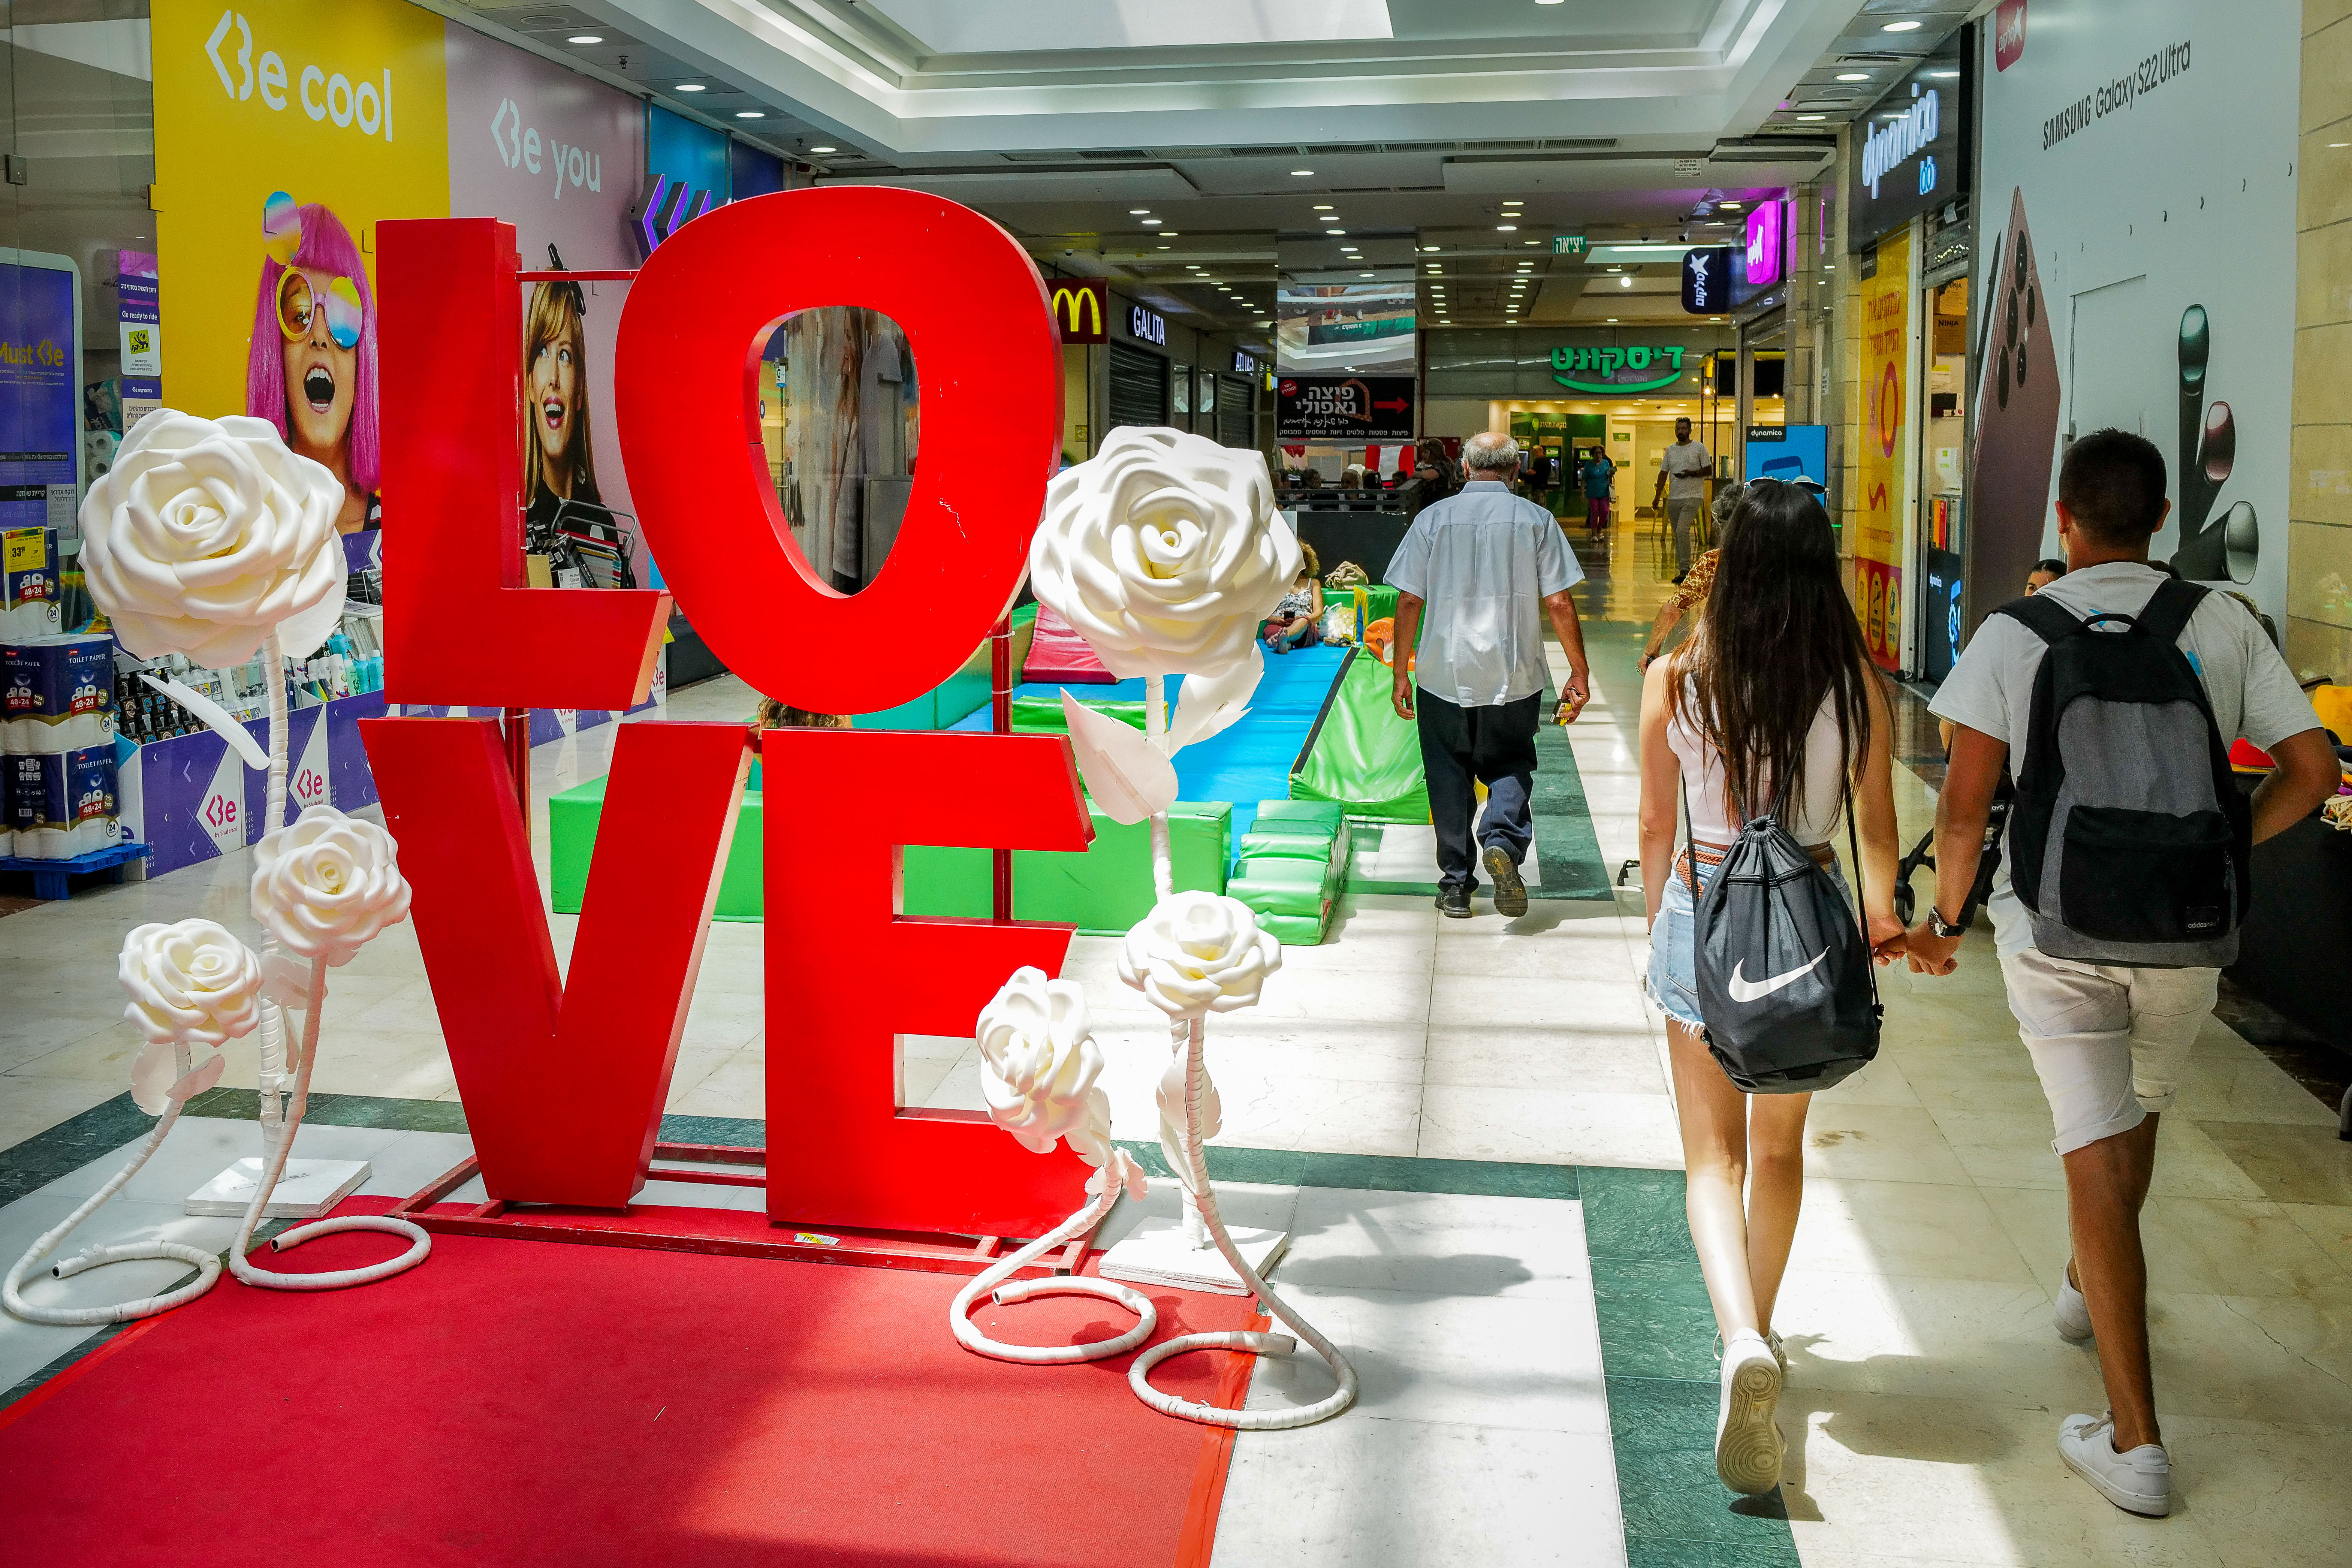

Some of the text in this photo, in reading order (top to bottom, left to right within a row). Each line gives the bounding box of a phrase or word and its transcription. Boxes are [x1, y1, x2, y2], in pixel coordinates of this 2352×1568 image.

[2043, 40, 2191, 151] SAMSUNG Galaxy S22 Ultra
[300, 64, 392, 142] cool
[1861, 82, 1939, 199] dynamica
[550, 139, 600, 200] you
[1555, 236, 1584, 254] יציאה
[1693, 272, 1707, 307] סלקום
[130, 312, 142, 320] ready
[1133, 306, 1166, 346] GALITA
[0, 342, 33, 365] Must
[1550, 346, 1686, 378] דיסקונט
[1281, 386, 1296, 394] למהדרין
[1308, 386, 1354, 400] פיצה
[1296, 398, 1356, 414] נאפולי
[1751, 429, 1782, 437] dynamica
[12, 547, 21, 558] 33
[24, 586, 42, 596] 48=24
[75, 697, 94, 709] 48=24
[103, 719, 110, 727] 24
[78, 761, 96, 769] TOILET
[83, 802, 102, 814] 48=24
[308, 798, 323, 806] Shufersal
[109, 823, 116, 832] 24
[220, 826, 237, 836] Shufersal
